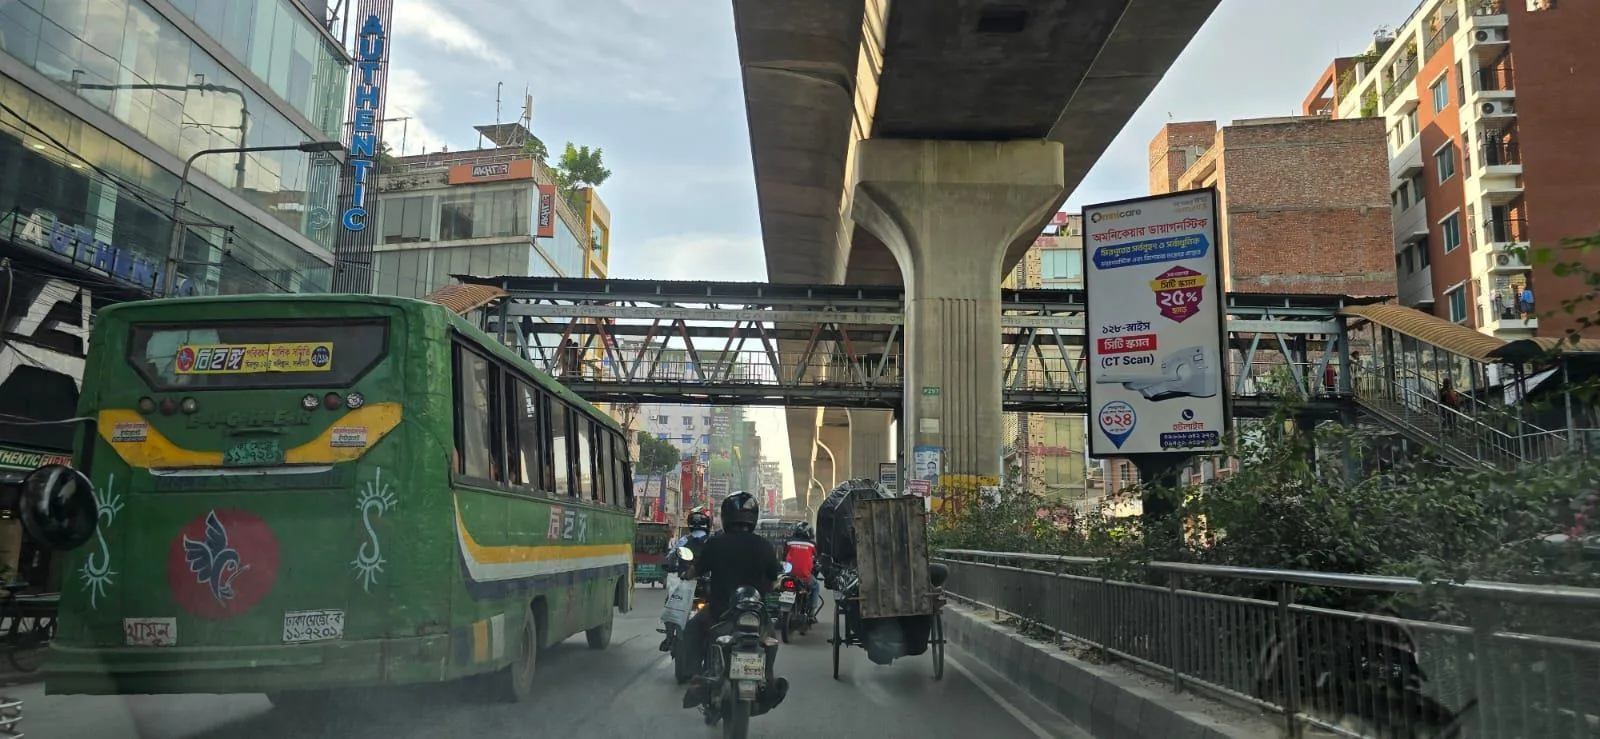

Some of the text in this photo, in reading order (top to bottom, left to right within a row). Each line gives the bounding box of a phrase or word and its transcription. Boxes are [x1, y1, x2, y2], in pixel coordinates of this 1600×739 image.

[342, 15, 384, 231] AUTHENTIC
[1148, 217, 1208, 235] ডায়াগনস্টিক
[1160, 279, 1176, 288] সিটি
[1160, 290, 1198, 306] ২৫%
[1102, 320, 1151, 334] ১২৮-স্লাইস
[1104, 338, 1150, 350] সিটি স্ক্যান
[1101, 353, 1154, 369] (CT Scan)
[1102, 413, 1132, 428] ৩২৪
[127, 622, 170, 644] থামুন
[287, 626, 338, 640] ১১-৭২০১
